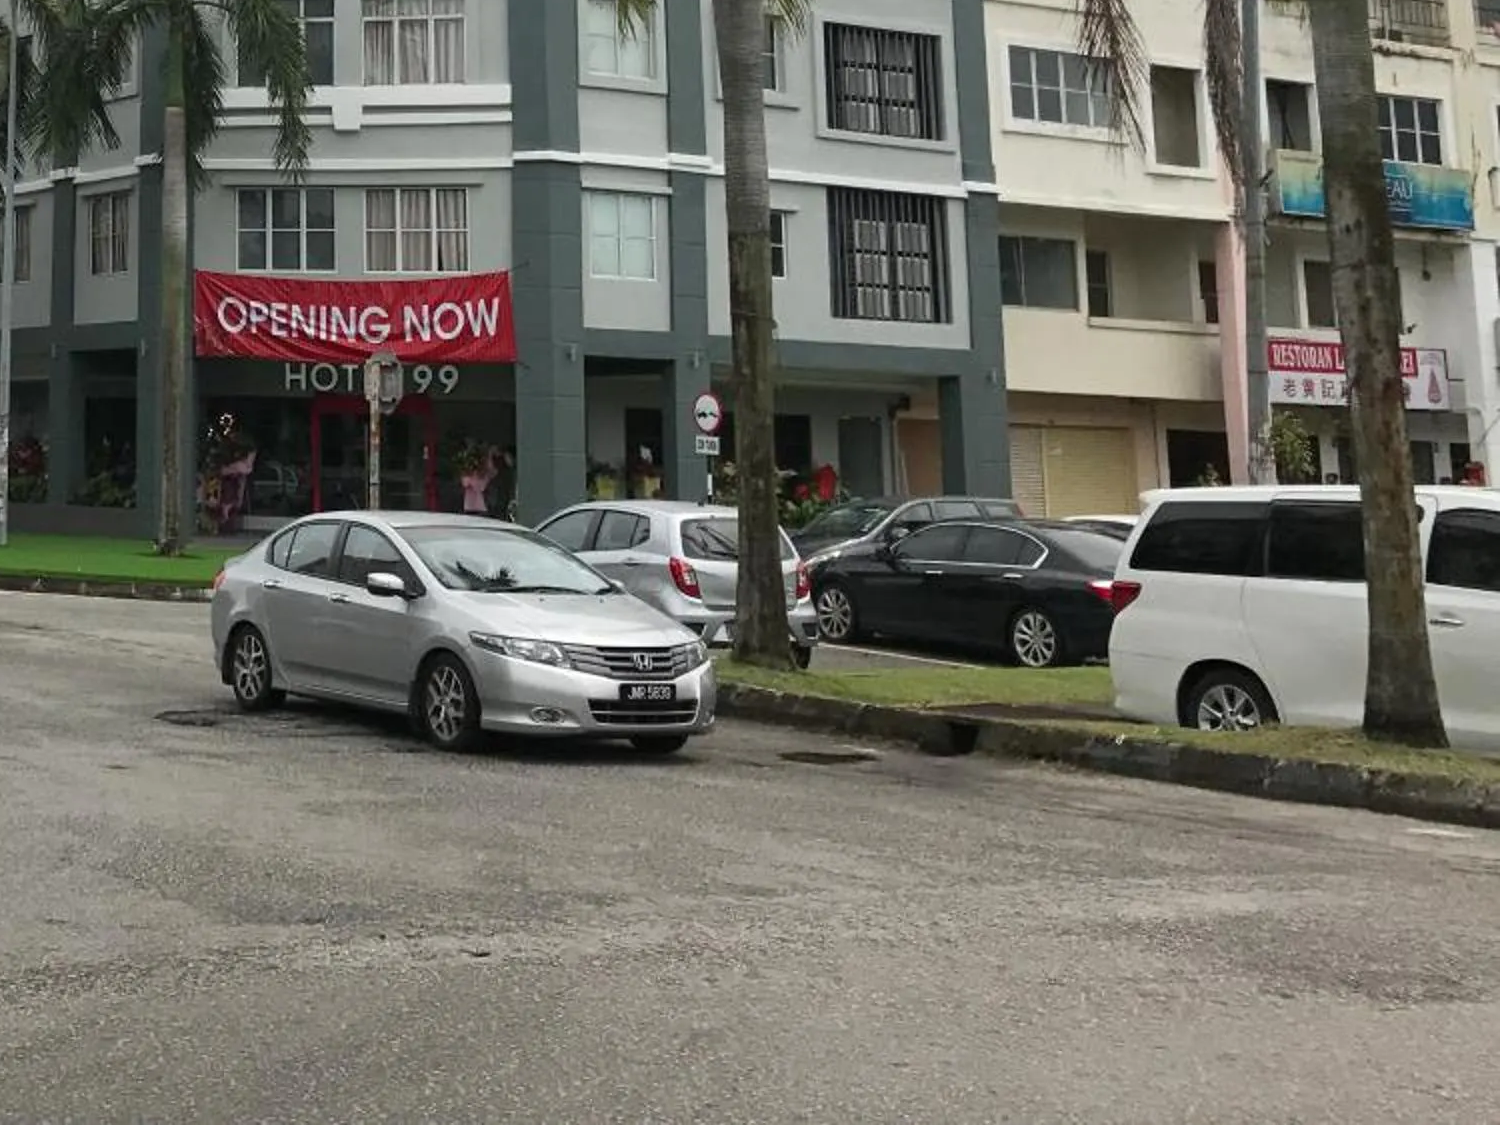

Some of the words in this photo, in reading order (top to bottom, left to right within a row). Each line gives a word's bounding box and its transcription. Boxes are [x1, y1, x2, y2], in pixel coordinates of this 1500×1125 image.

[217, 295, 391, 344] OPENING
[403, 296, 500, 342] NOW
[1271, 343, 1333, 370] RESTORAN
[285, 362, 404, 393] HOT
[413, 364, 460, 394] 99
